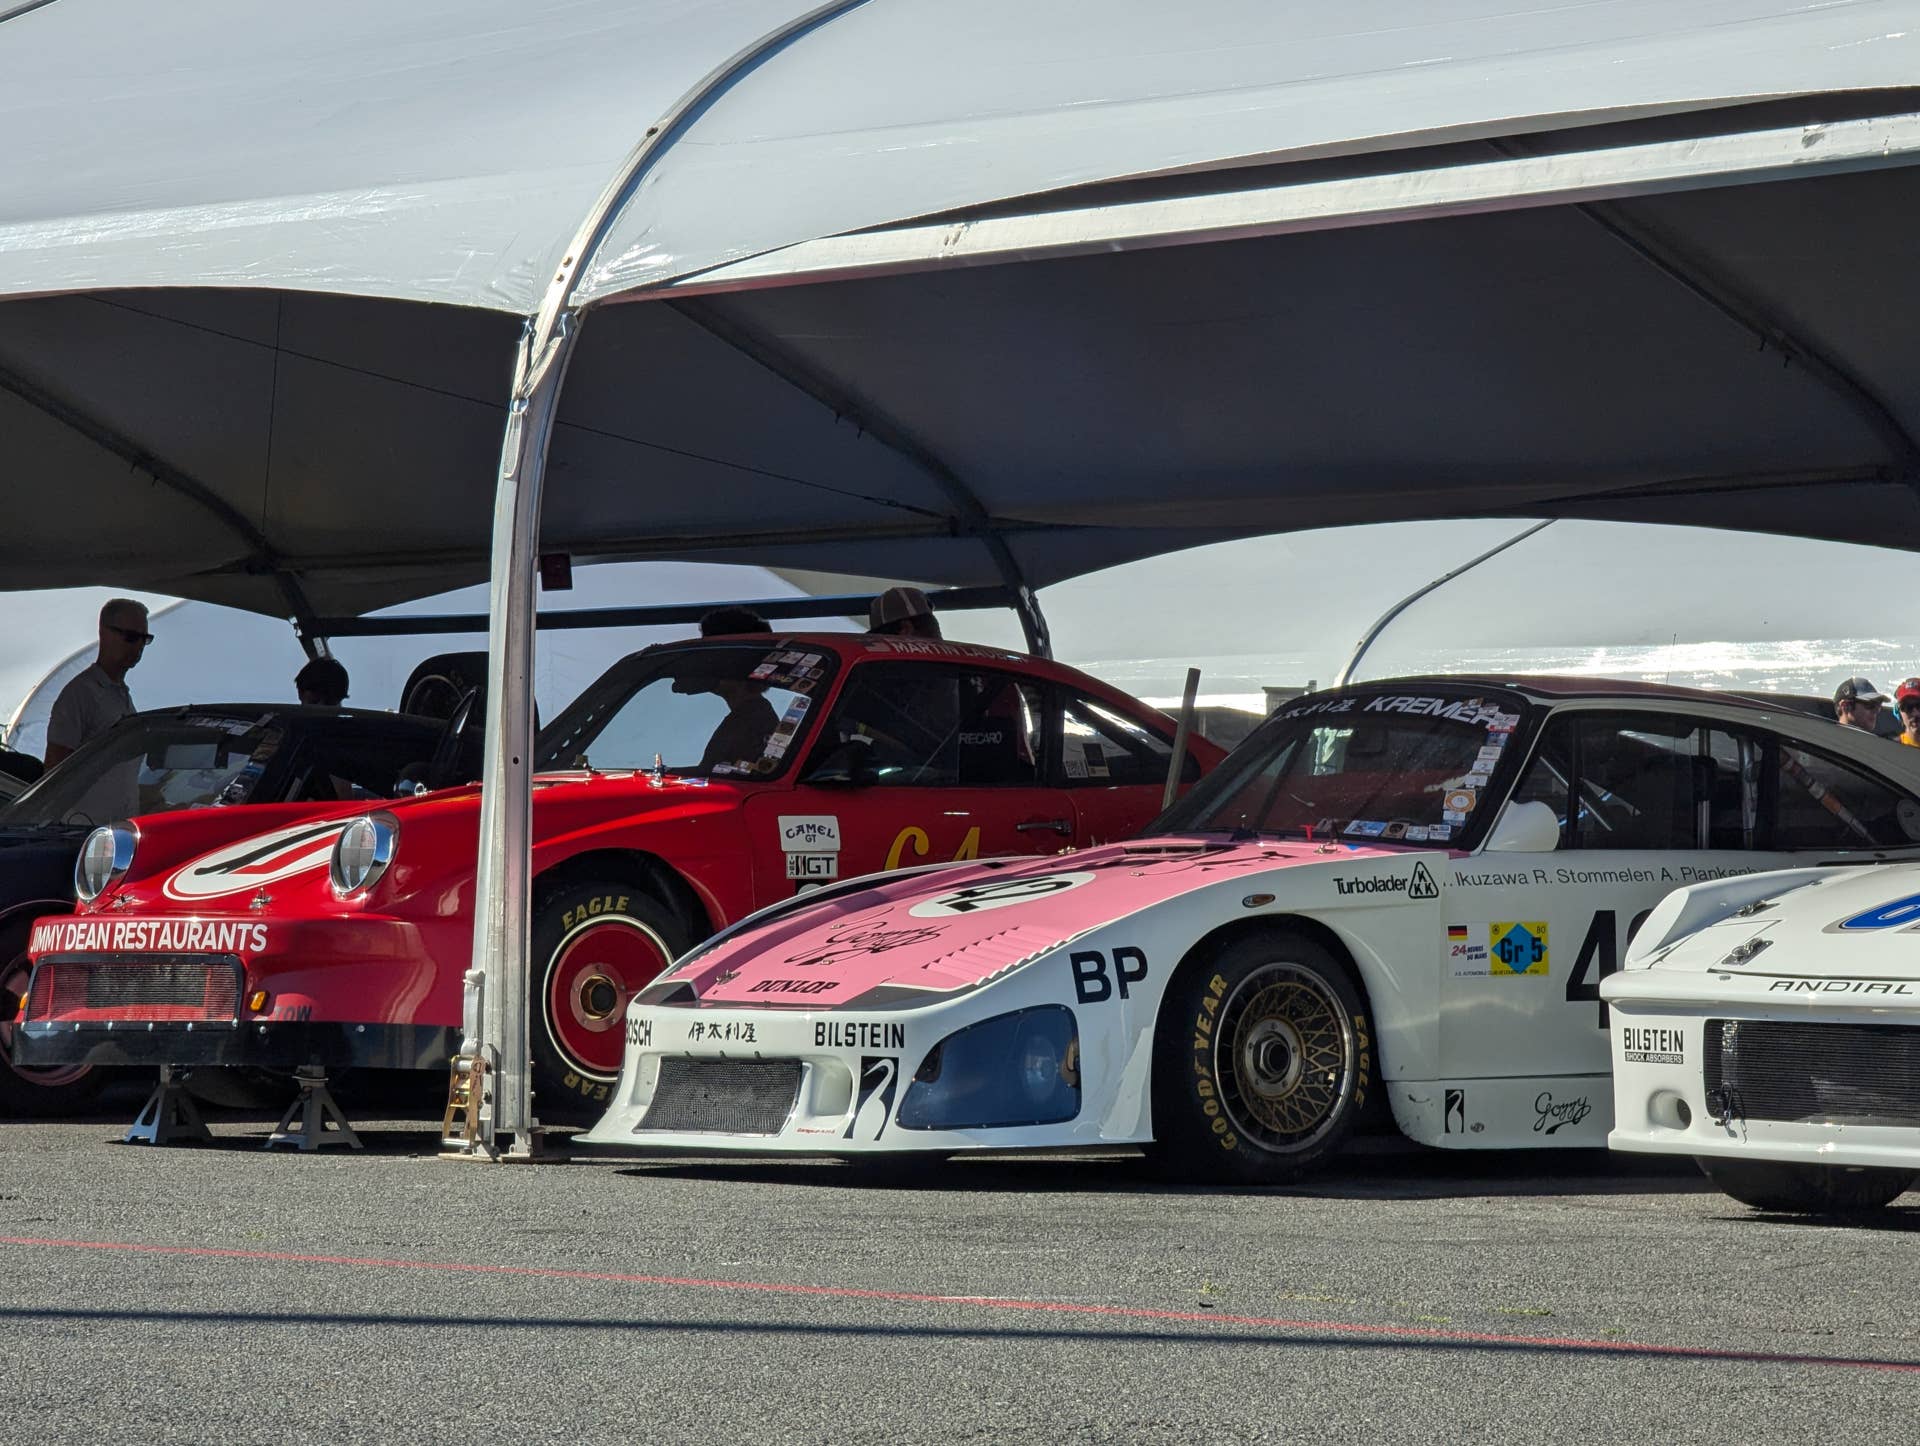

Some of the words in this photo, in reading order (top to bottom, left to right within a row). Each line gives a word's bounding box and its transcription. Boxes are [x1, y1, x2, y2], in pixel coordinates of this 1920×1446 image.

[890, 641, 959, 656] MARTIN
[958, 731, 1003, 745] RECARO
[785, 824, 835, 839] CAMEL
[805, 834, 816, 843] GT
[807, 857, 835, 874] GT
[1333, 874, 1408, 895] Turbolader
[1455, 871, 1529, 886] Ikuzawa
[1532, 869, 1553, 884] R.
[1556, 866, 1655, 884] Stommelen
[1660, 867, 1677, 882] A.
[562, 895, 629, 931] EAGLE
[30, 924, 65, 953] JIMMY
[65, 922, 112, 951] DEAN
[112, 921, 268, 952] RESTAURANTS
[1451, 944, 1466, 956] 24
[1500, 937, 1524, 964] Gr
[1531, 937, 1543, 963] 5
[1069, 946, 1149, 1005] BP
[747, 980, 840, 994] DUNLOP
[1768, 980, 1914, 995] ANDIAL
[275, 1006, 312, 1021] TOW
[687, 1021, 758, 1043] 伊太利屋
[814, 1021, 905, 1048] BILSTEIN
[1623, 1027, 1684, 1052] BILSTEIN
[1194, 974, 1238, 1150] GOODYEAR
[1353, 1015, 1370, 1109] EAGLE
[1626, 1052, 1645, 1062] SHOCK
[1645, 1053, 1683, 1064] ABSORBERS
